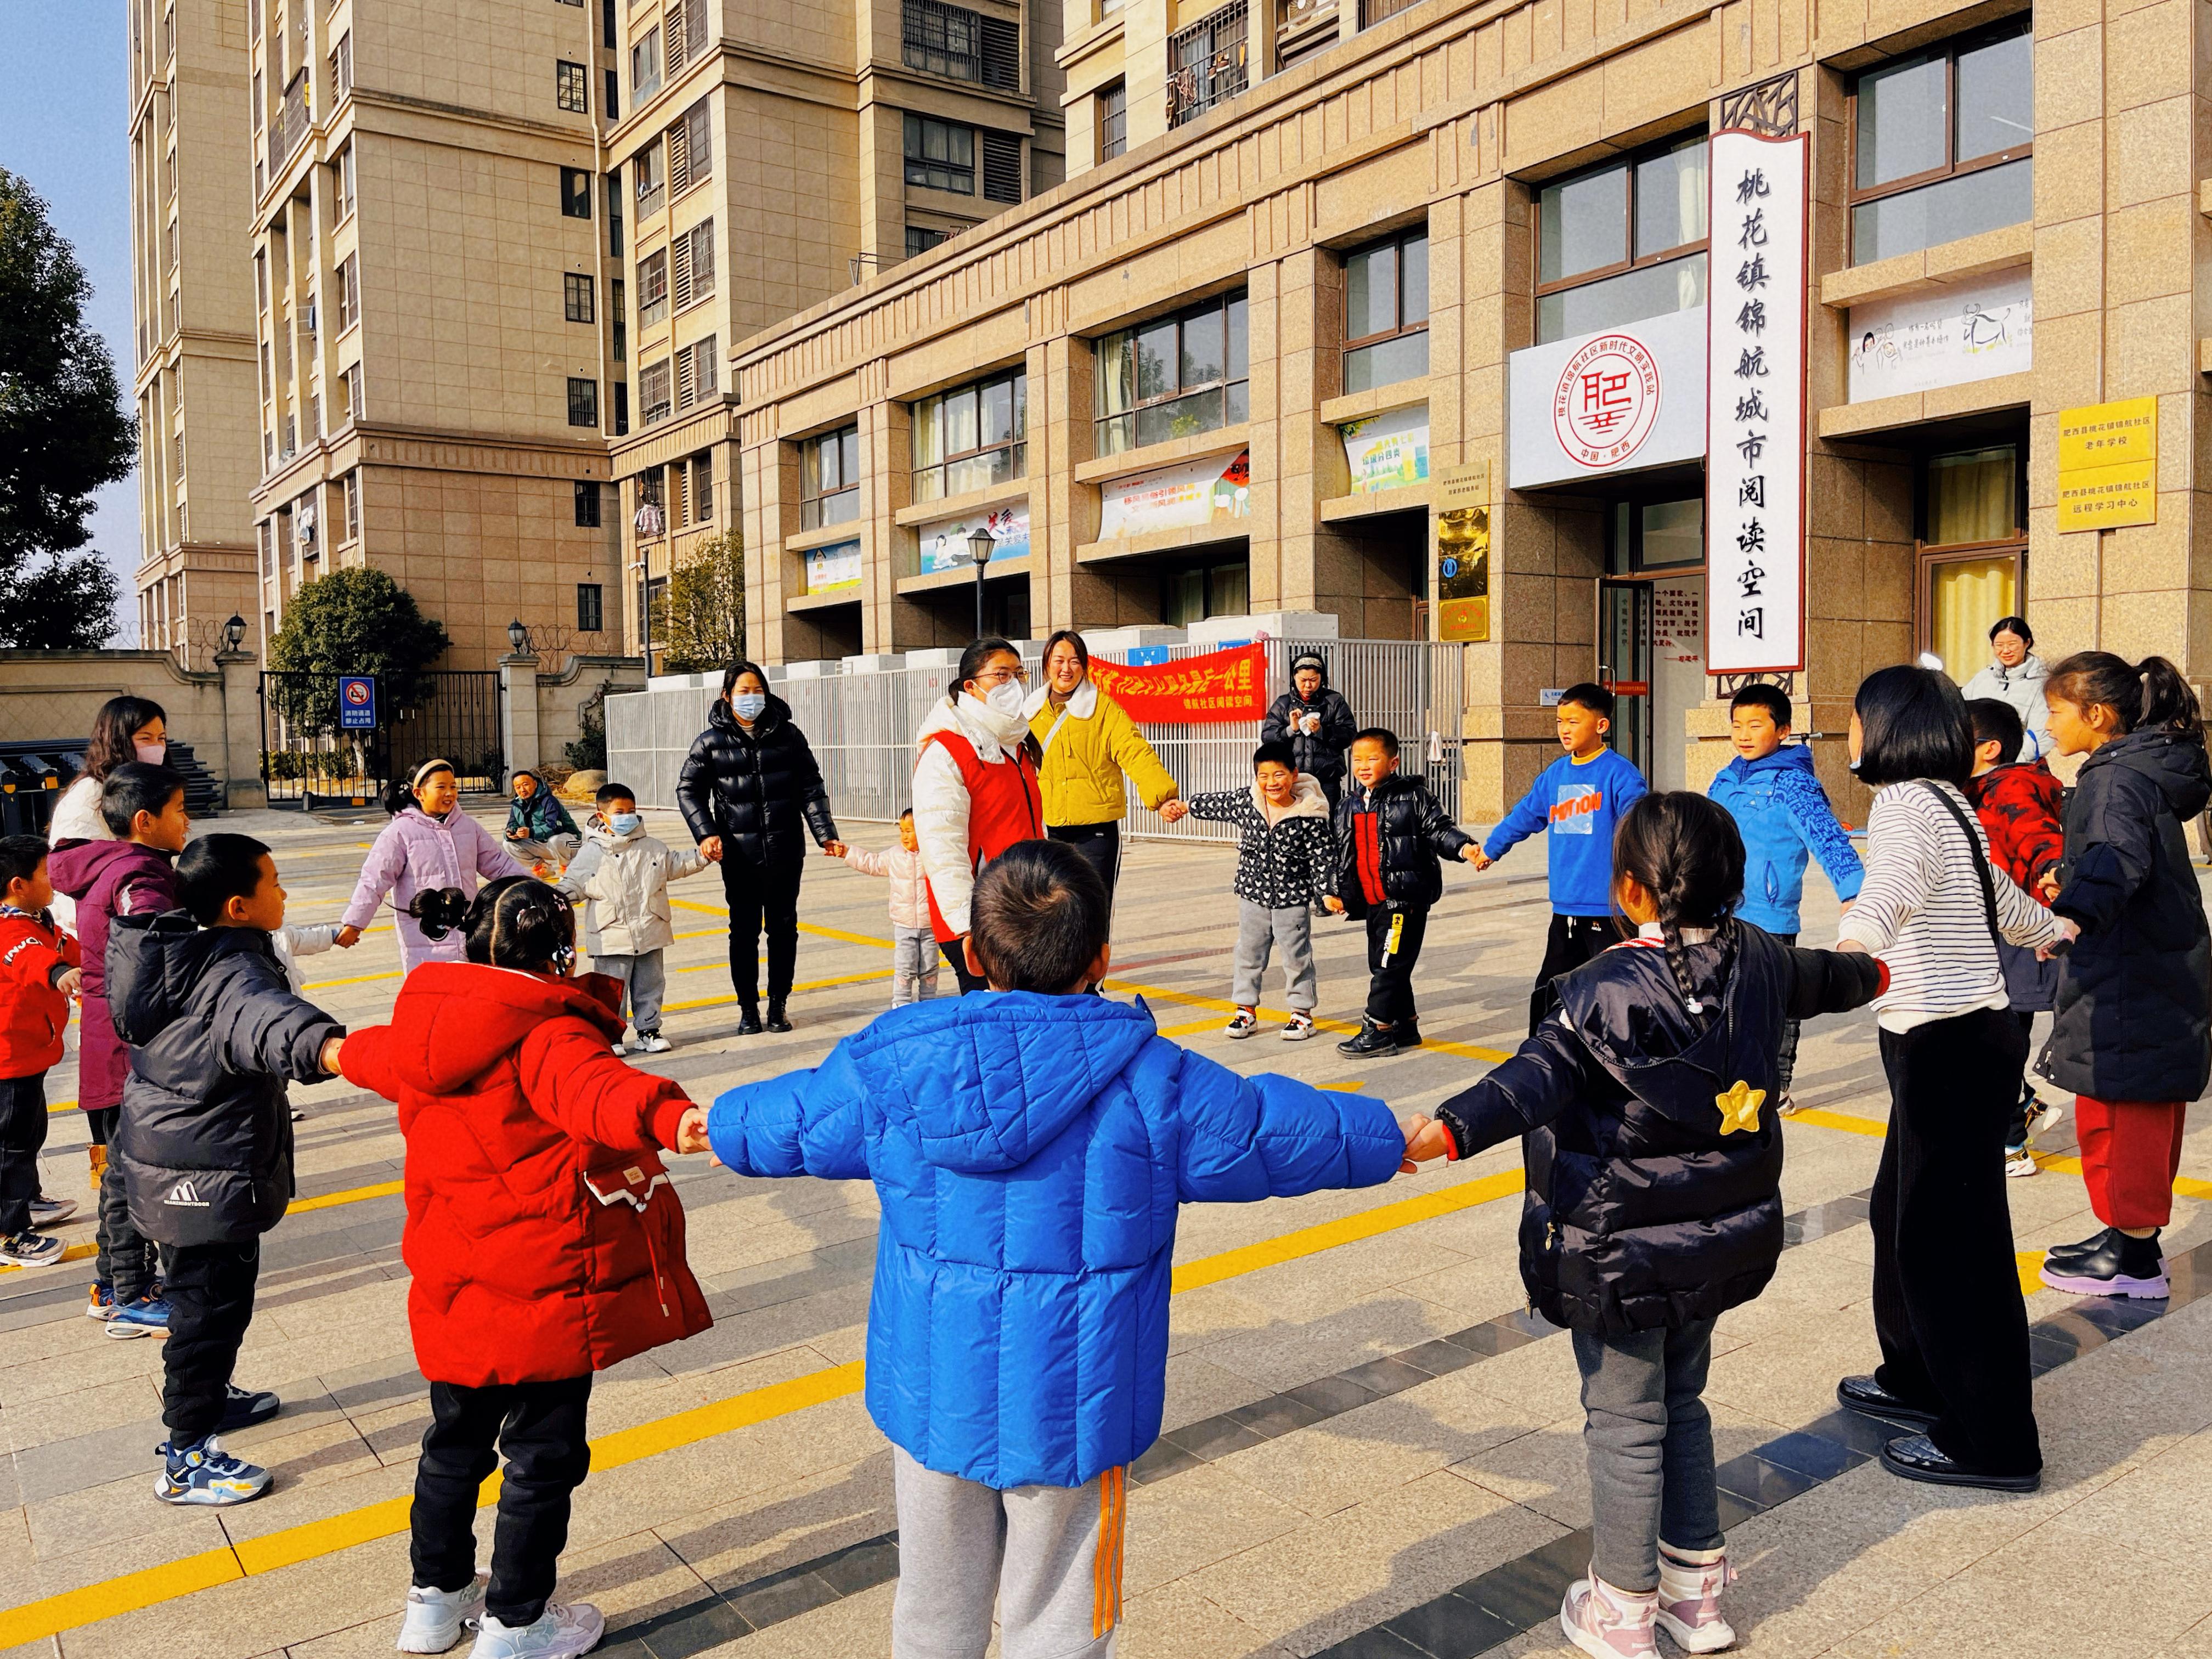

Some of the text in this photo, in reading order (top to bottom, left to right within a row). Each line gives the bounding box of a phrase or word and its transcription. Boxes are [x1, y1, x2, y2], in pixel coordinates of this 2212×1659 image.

[1558, 340, 1655, 417] 桃花镇锦航社区新时代文明实践站
[1734, 167, 1770, 639] 桃花镇锦航城市阅读空间
[2063, 416, 2150, 437] 肥西县桃花镇锦航社区
[2085, 436, 2128, 450] 老年学校
[2062, 481, 2150, 499] 肥西县桃花镇锦航社区
[2073, 499, 2138, 514] 远程学习中心
